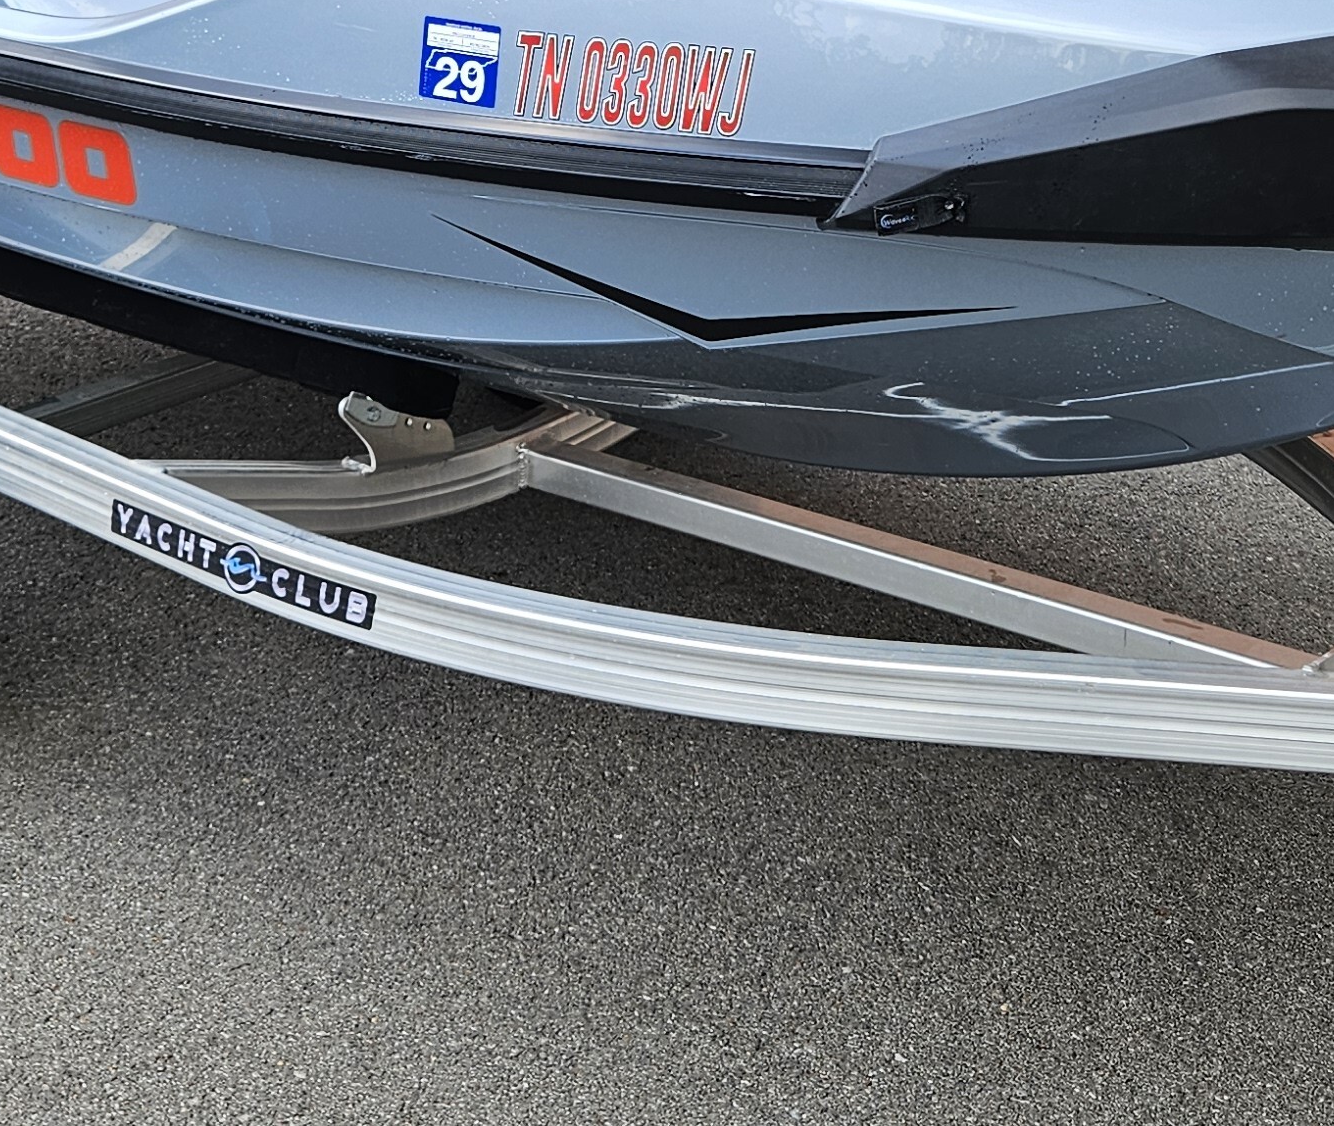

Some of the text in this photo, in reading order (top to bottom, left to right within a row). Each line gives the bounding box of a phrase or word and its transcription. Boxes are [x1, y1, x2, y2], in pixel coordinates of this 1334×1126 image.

[432, 56, 485, 103] 29
[513, 29, 757, 137] TN 0330WJ
[117, 502, 369, 624] YACHT CLUB
